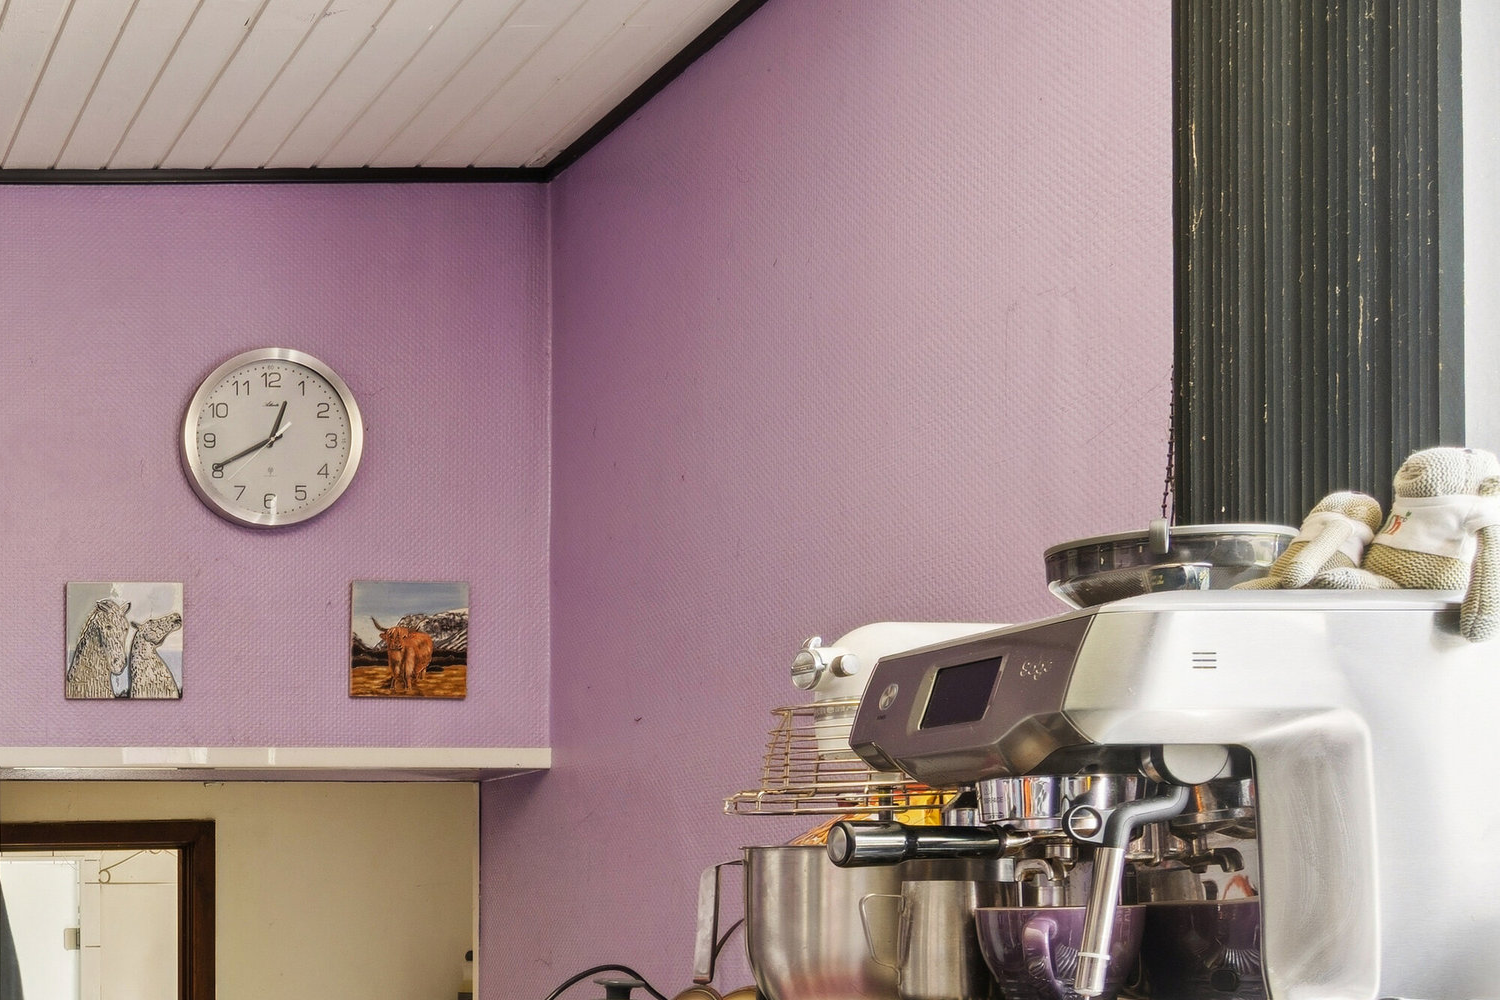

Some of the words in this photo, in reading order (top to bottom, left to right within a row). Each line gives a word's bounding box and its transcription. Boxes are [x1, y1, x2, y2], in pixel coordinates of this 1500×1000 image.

[232, 380, 250, 396] 11
[261, 372, 282, 388] 12
[297, 380, 305, 396] 1
[208, 402, 229, 419] 10
[316, 402, 330, 419] 2
[203, 432, 216, 449] 9
[325, 433, 338, 449] 3
[211, 463, 224, 479] 8
[317, 463, 330, 479] 4
[234, 485, 246, 501] 7
[263, 493, 276, 509] 6
[294, 485, 307, 501] 5
